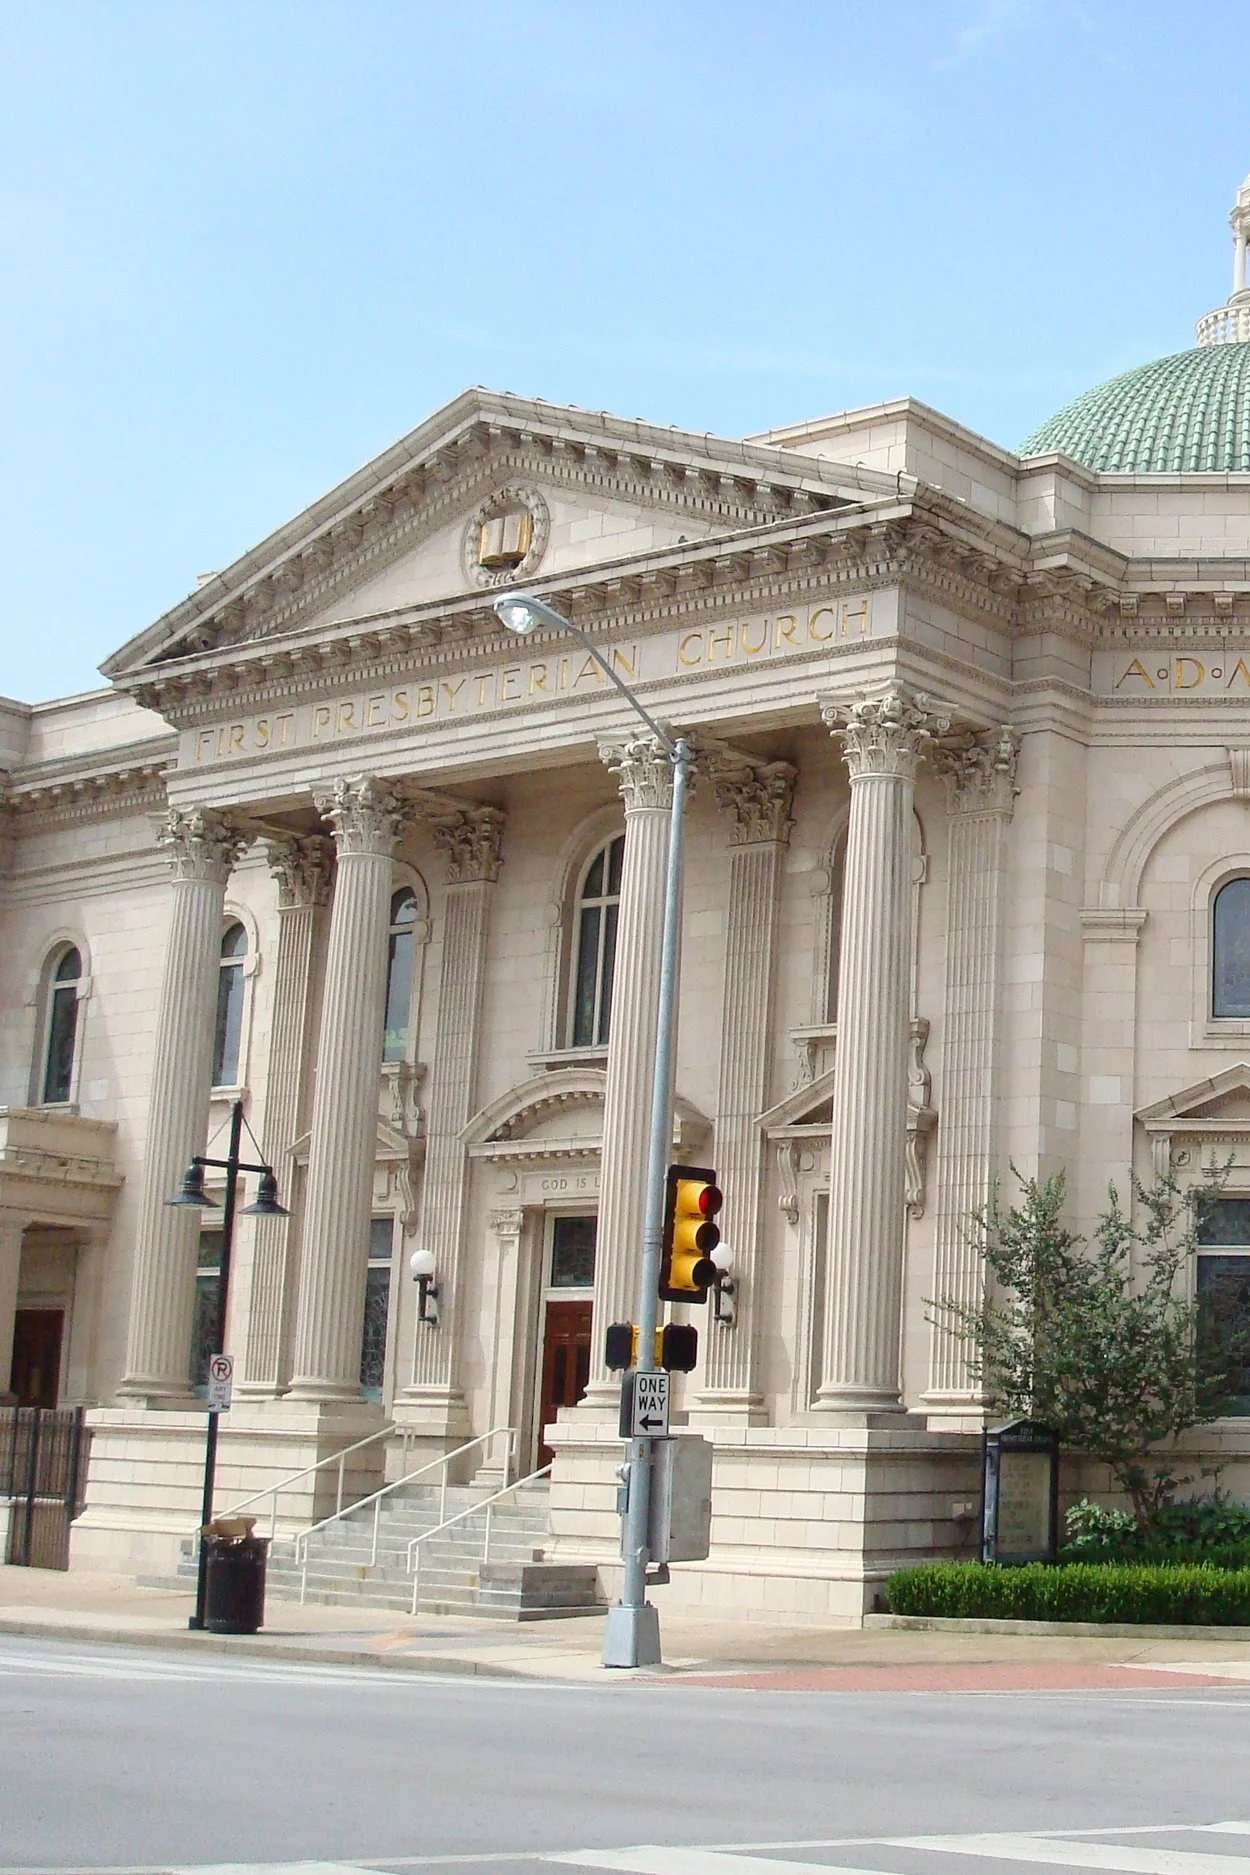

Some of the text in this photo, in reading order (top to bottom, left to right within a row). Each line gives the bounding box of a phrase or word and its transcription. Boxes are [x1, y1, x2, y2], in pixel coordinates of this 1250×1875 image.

[195, 600, 868, 760] FIRST PRESBYTERIAN CHURCH
[541, 1179, 568, 1191] GOD
[576, 1177, 587, 1189] IS
[639, 1377, 666, 1393] ONE
[638, 1396, 667, 1411] WAY
